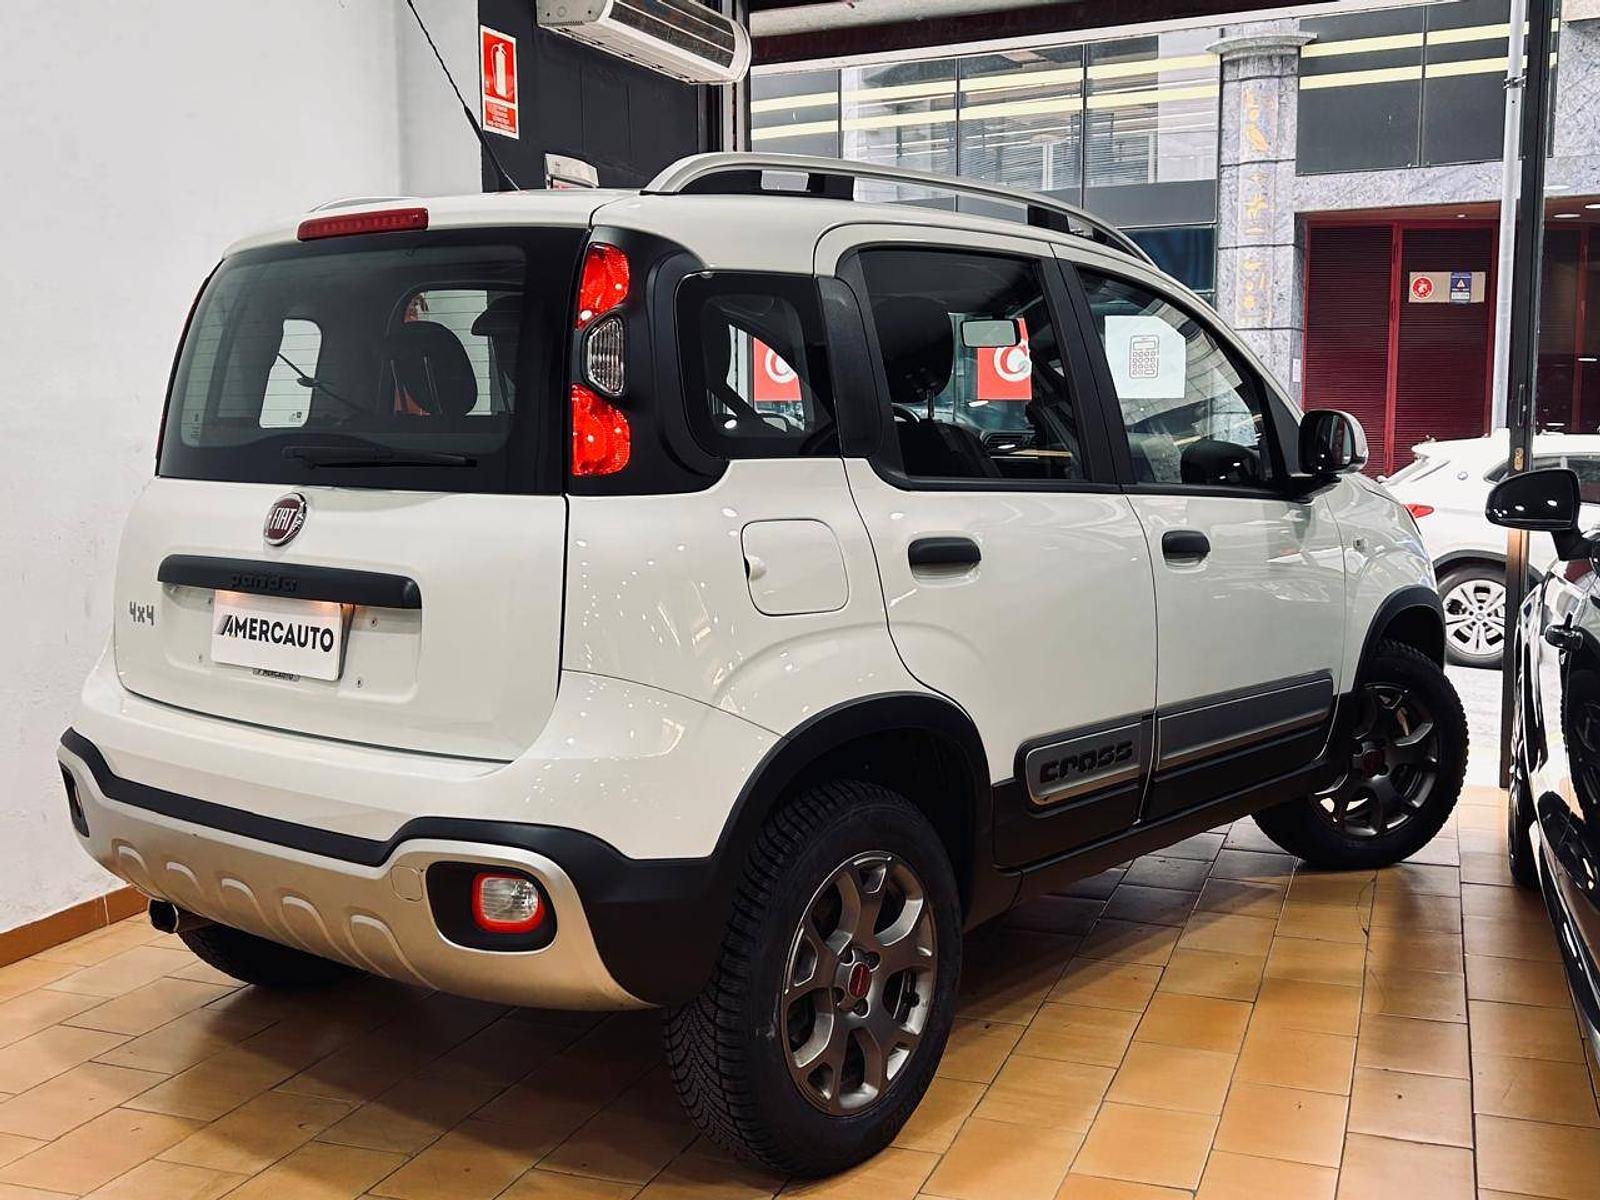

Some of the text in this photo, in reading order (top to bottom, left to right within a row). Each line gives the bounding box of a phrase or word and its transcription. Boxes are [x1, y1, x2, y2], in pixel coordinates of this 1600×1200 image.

[270, 507, 297, 530] FIAT
[129, 601, 154, 626] 4x4
[216, 614, 334, 652] AMERCAUTO
